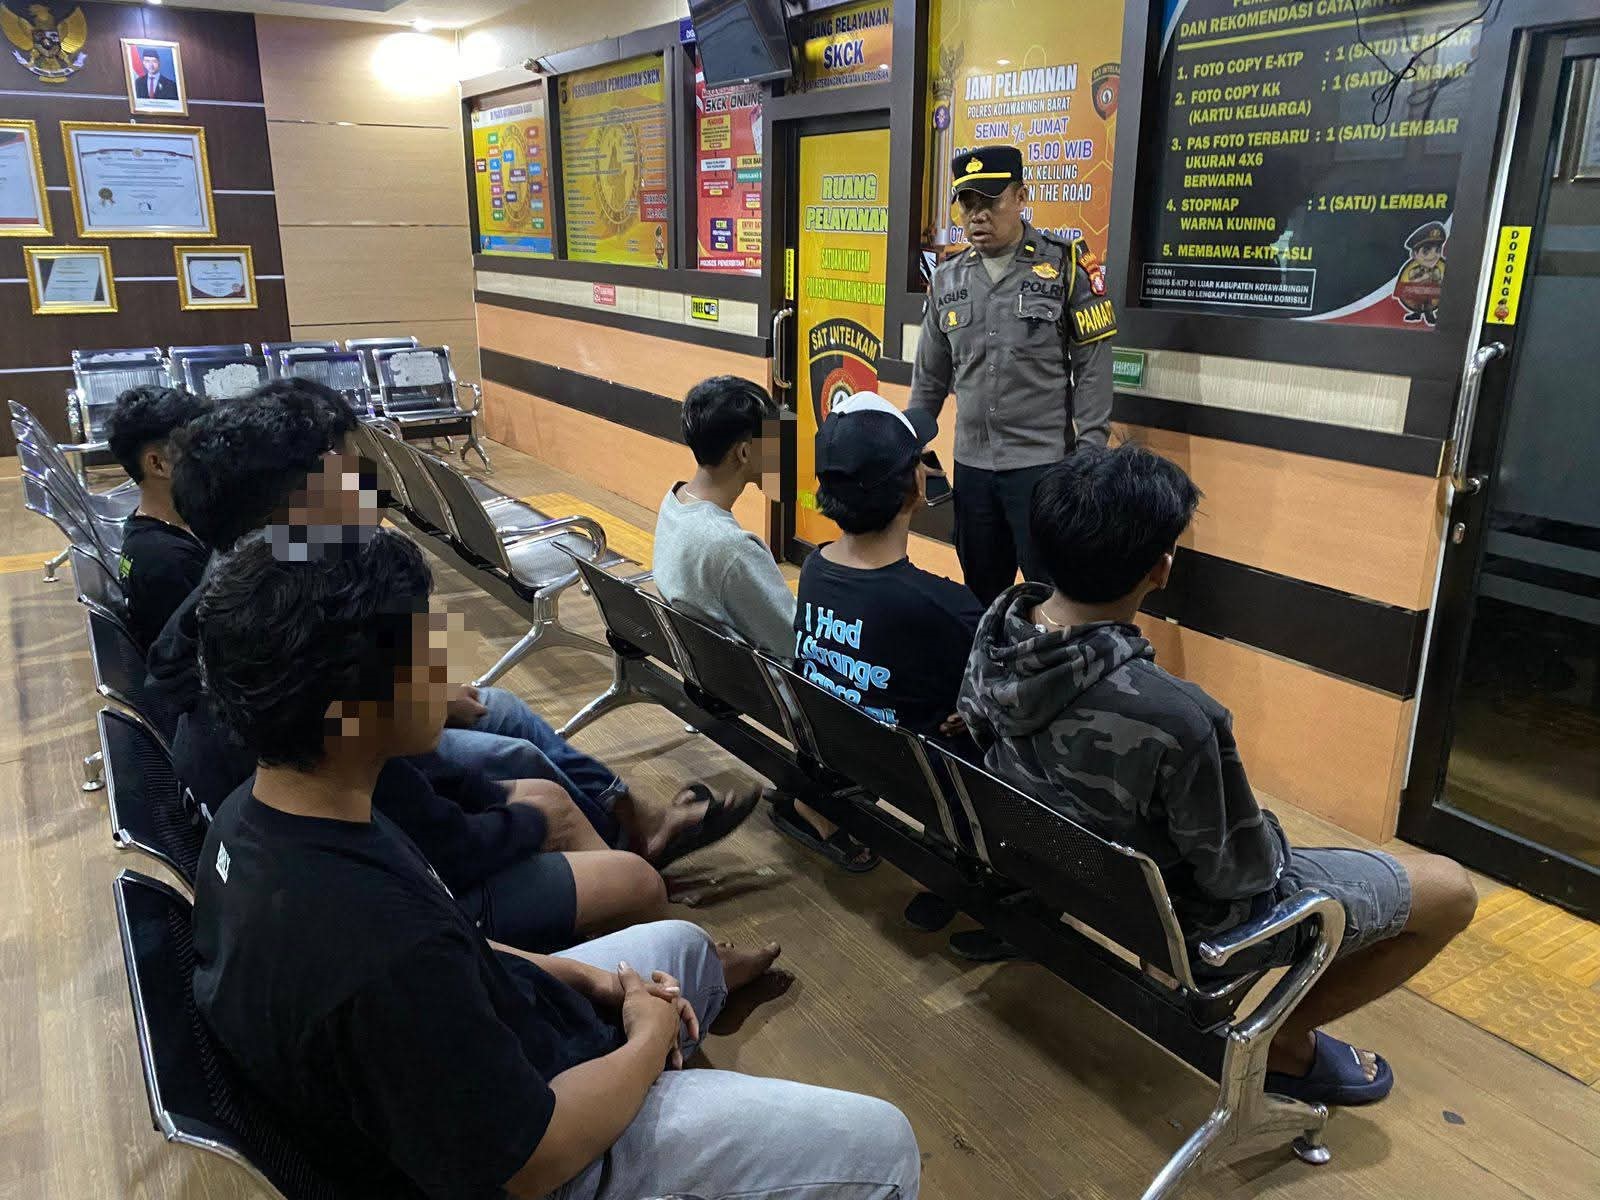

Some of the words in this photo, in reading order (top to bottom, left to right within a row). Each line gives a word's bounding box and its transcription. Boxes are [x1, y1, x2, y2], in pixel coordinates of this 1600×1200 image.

[835, 7, 889, 33] PELAYANAN
[1180, 20, 1207, 38] DAN
[1211, 4, 1313, 33] REKOMENDASI
[823, 39, 864, 69] SKCK
[1177, 66, 1188, 80] 1.
[1193, 61, 1224, 78] FOTO
[1227, 56, 1262, 74] COPY
[1265, 51, 1304, 69] E-KTP
[1335, 46, 1345, 61] 1
[1349, 38, 1398, 62] (SATU)
[1401, 28, 1472, 53] LEMBAR
[965, 75, 993, 101] JAM
[995, 63, 1078, 98] PELAYANAN
[1175, 92, 1186, 106] 2.
[1191, 88, 1221, 104] FOTO
[1224, 84, 1261, 101] COPY
[1262, 82, 1281, 97] KK
[1332, 74, 1342, 91] 1
[705, 96, 728, 112] SKCK
[967, 104, 992, 119] POLRES
[993, 100, 1045, 116] KOTAWARINGIN
[1047, 96, 1071, 113] BARAT
[1188, 107, 1233, 125] (KARTU
[1235, 100, 1312, 120] KELUARGA)
[975, 122, 1009, 139] SENIN
[1028, 117, 1069, 136] JUMAT
[1171, 137, 1182, 151] 3.
[1187, 136, 1210, 150] PAS
[1213, 133, 1245, 148] FOTO
[1248, 129, 1310, 146] TERBARU
[1326, 126, 1335, 142] 1
[1338, 124, 1386, 144] (SATU)
[1390, 118, 1459, 138] LEMBAR
[1028, 143, 1060, 160] 15.00
[1064, 140, 1093, 158] WIB
[1185, 154, 1236, 169] UKURAN
[1238, 152, 1264, 167] 4X6
[1022, 165, 1034, 180] CK
[1036, 164, 1078, 180] KELILING
[1183, 173, 1253, 188] BERWARNA
[821, 174, 877, 201] RUANG
[1039, 183, 1060, 201] THE
[1062, 183, 1092, 201] ROAD
[1166, 199, 1177, 212] 4.
[1181, 198, 1240, 212] STOPMAP
[1318, 195, 1327, 210] 1
[1330, 195, 1377, 212] (SATU)
[1380, 193, 1448, 210] LEMBAR
[805, 205, 888, 232] PELAYANAN
[1180, 217, 1224, 231] WARNA
[1226, 217, 1276, 231] KUNING
[1162, 244, 1173, 256] 5.
[1178, 244, 1240, 258] MEMBAWA
[1243, 245, 1279, 259] E-KTP
[1282, 246, 1313, 260] ASLI
[1147, 268, 1172, 276] CATATAN
[1502, 230, 1519, 297] DORONG
[1020, 280, 1065, 297] POLRI
[1166, 288, 1187, 297] HARUS
[1195, 290, 1227, 299] LENGKAPI
[1228, 292, 1273, 302] KETERANGAN
[1274, 295, 1307, 304] DOMISILI
[1171, 279, 1188, 287] E-KTP
[1197, 280, 1214, 288] LUAR
[1215, 281, 1254, 291] KABUPATEN
[1254, 283, 1309, 293] KOTAWARINGIN
[938, 288, 968, 307] AGUS
[811, 327, 828, 351] SAT
[829, 325, 878, 362] INTELKAM
[805, 602, 812, 632] I
[815, 606, 863, 649] Had
[801, 635, 891, 691] Strange
